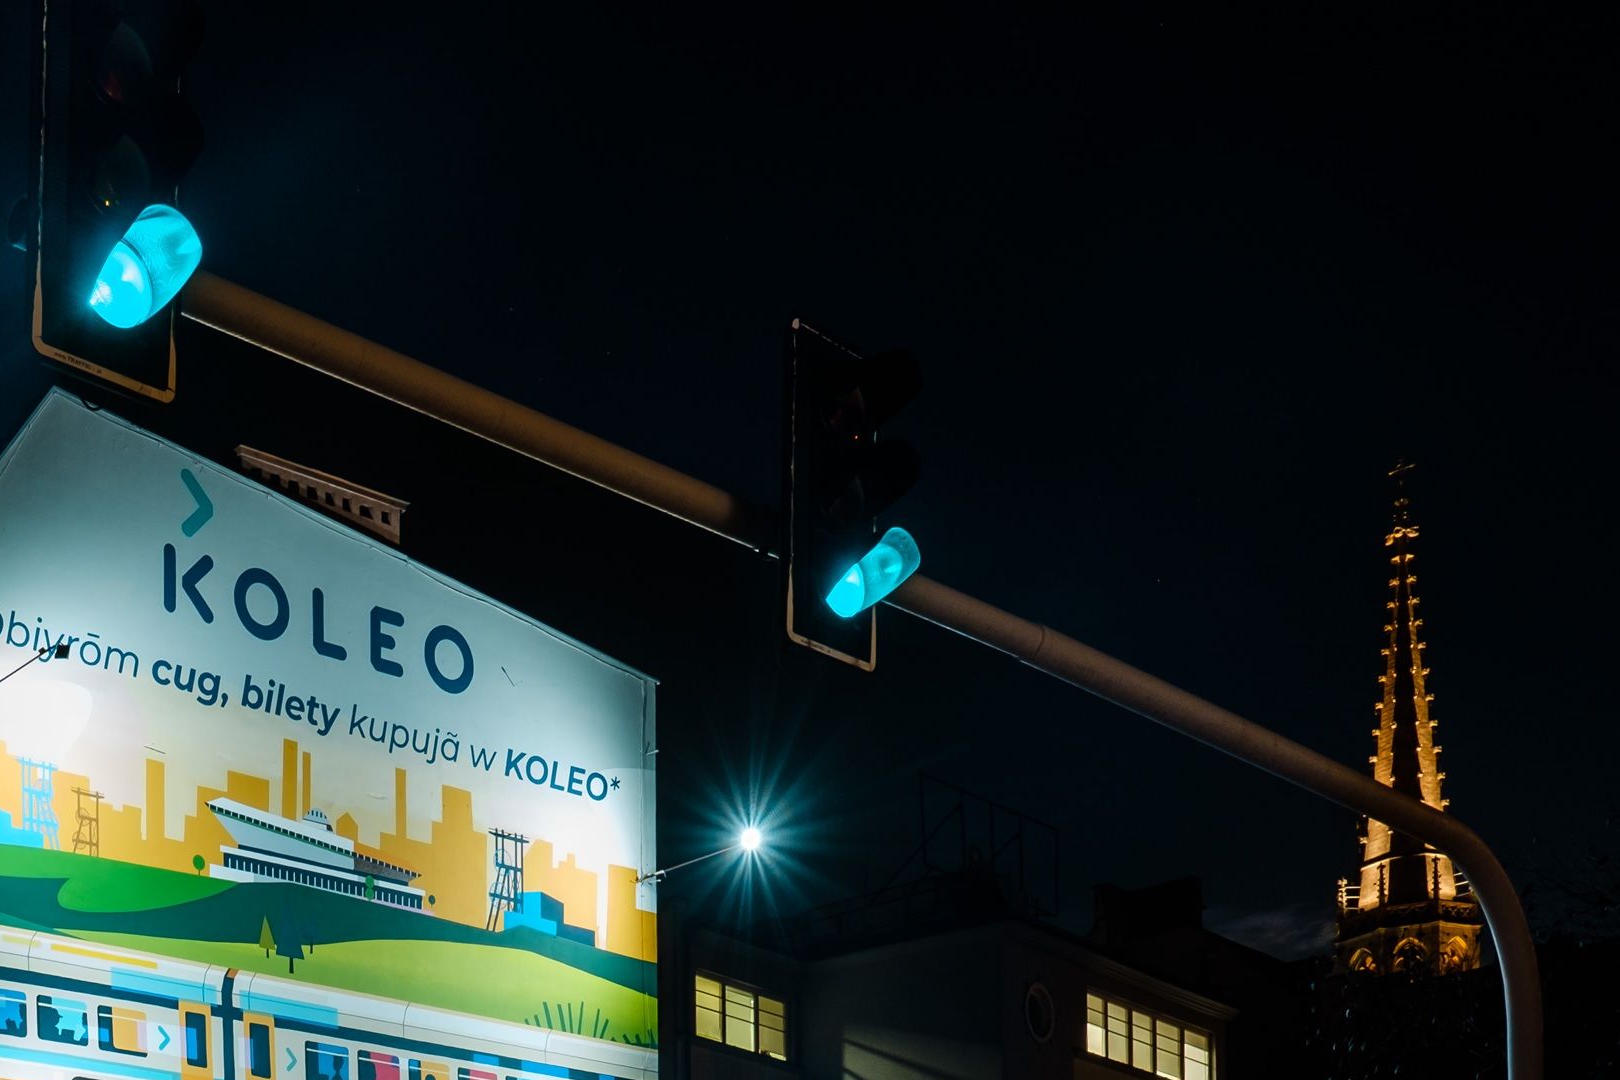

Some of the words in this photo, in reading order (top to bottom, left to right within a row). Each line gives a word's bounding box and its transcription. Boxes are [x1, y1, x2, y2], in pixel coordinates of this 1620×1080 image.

[163, 543, 474, 694] KOLEO
[152, 659, 229, 708] cug,
[241, 674, 341, 737] bilety
[349, 703, 460, 765] kupujã
[470, 744, 497, 771] w
